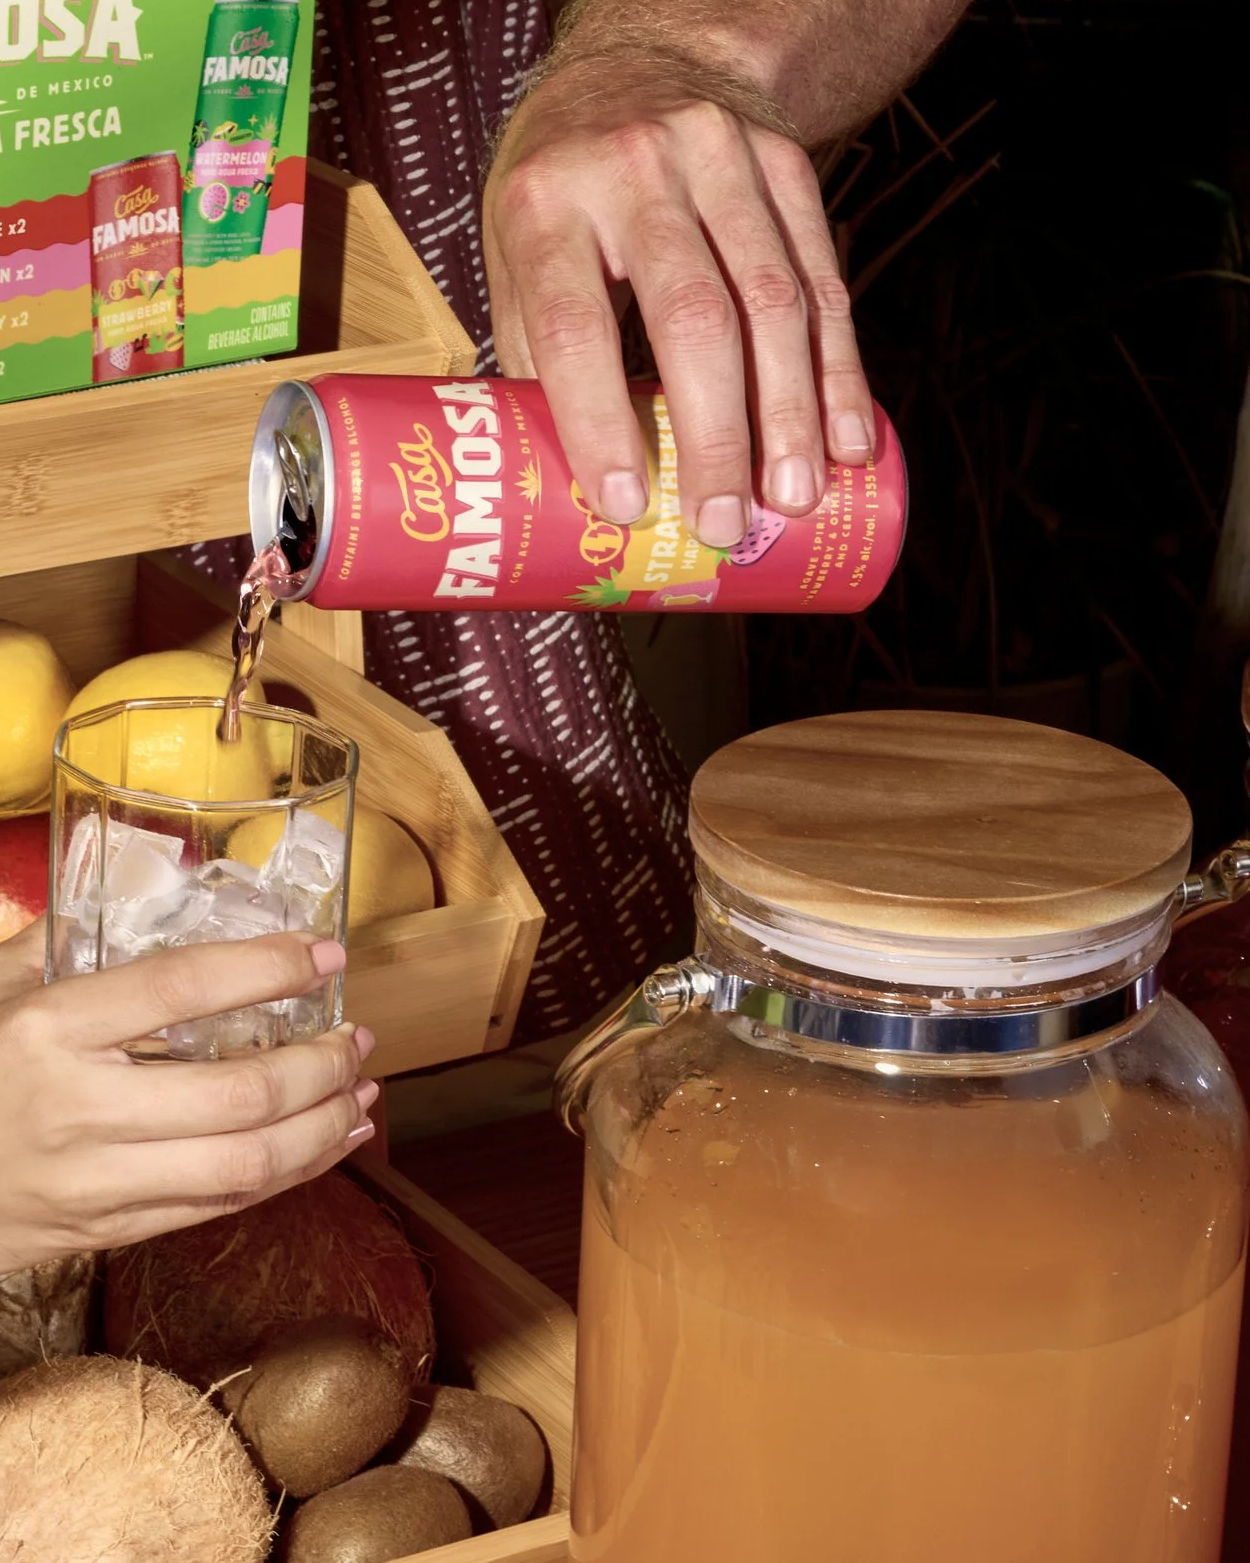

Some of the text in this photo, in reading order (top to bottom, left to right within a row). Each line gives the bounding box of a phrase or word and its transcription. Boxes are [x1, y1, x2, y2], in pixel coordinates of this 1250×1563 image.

[230, 26, 275, 55] Casa
[16, 74, 113, 100] DE MEXICO
[202, 55, 289, 87] FAMOSA
[14, 106, 122, 151] FRESCA
[114, 184, 160, 219] Casa
[8, 218, 27, 236] x2
[92, 205, 181, 256] FAMOSA
[15, 264, 35, 281] x2
[10, 311, 29, 328] x2
[250, 301, 292, 324] CONTAINS
[207, 320, 289, 351] BEVERAGE ALCOHOL
[337, 396, 359, 446] ALCOHOL
[505, 391, 531, 454] DE MEXICO
[388, 422, 453, 542] Casa
[432, 380, 503, 598] FAMOSA
[830, 481, 840, 526] OTHER
[835, 468, 853, 568] AND CERTIFIED
[510, 514, 533, 584] CON AGAVE
[828, 532, 837, 540] &
[850, 563, 867, 588] 4.5%
[865, 474, 877, 498] 355
[338, 525, 360, 580] CONTAINS
[680, 533, 701, 570] HAR
[800, 556, 819, 590] AGAVE
